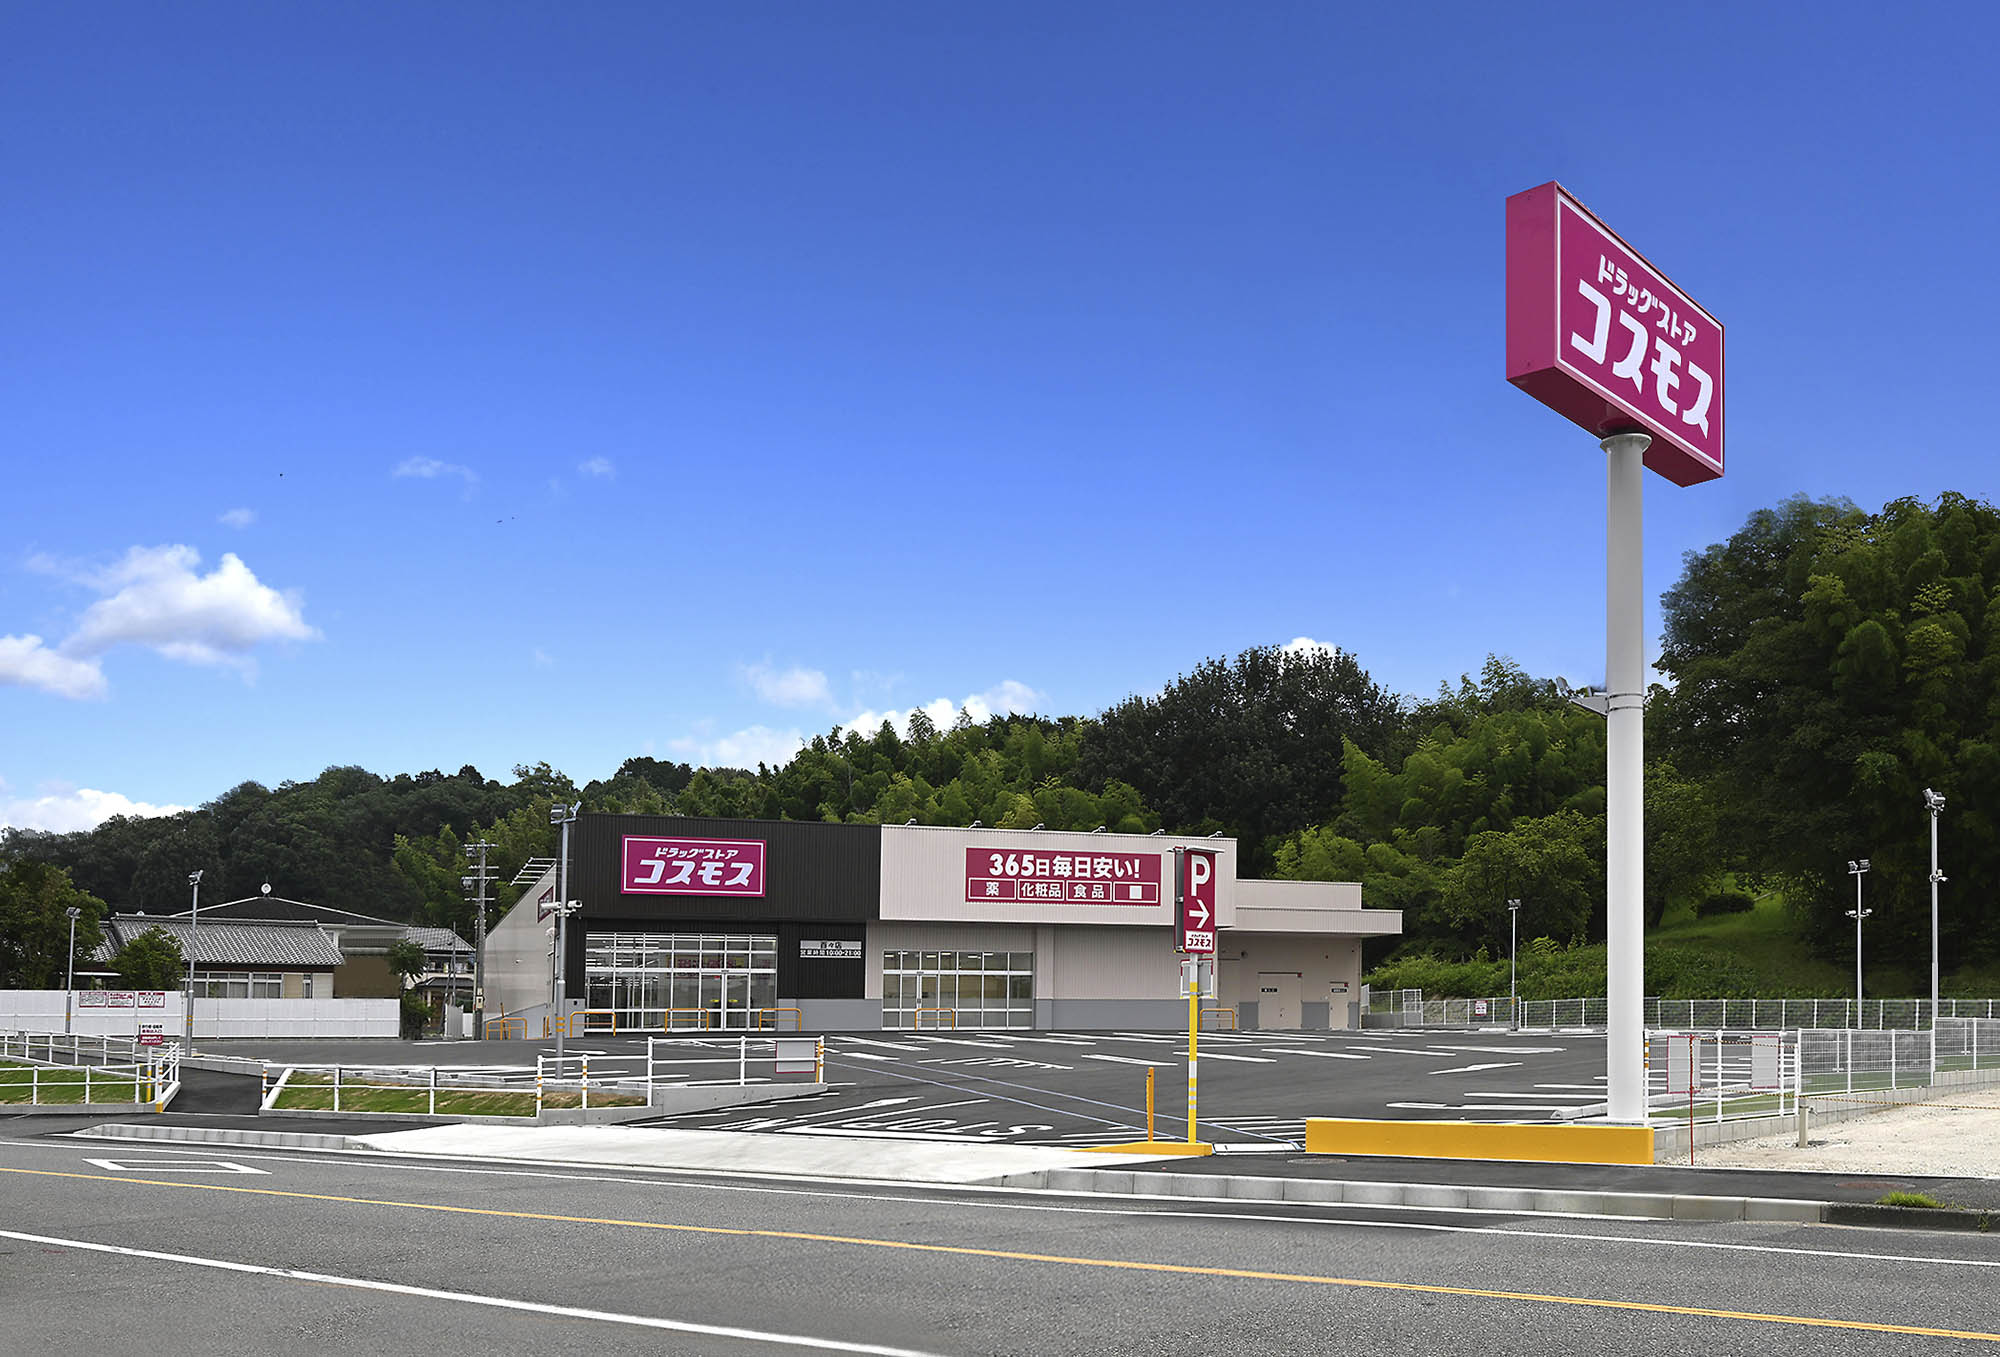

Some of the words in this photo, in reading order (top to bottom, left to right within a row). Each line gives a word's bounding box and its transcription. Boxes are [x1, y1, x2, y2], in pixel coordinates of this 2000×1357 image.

[1598, 254, 1697, 346] ドラッグストア
[1570, 278, 1714, 439] コスモス
[655, 846, 739, 860] ドラッグストア
[633, 859, 754, 887] コスモス
[989, 853, 1141, 879] 365日毎日安い!
[1191, 854, 1211, 897] P
[985, 881, 1000, 896] 薬
[1021, 882, 1062, 898] 化粧品
[1187, 937, 1211, 947] コスモス
[842, 1118, 1053, 1136] STOP
